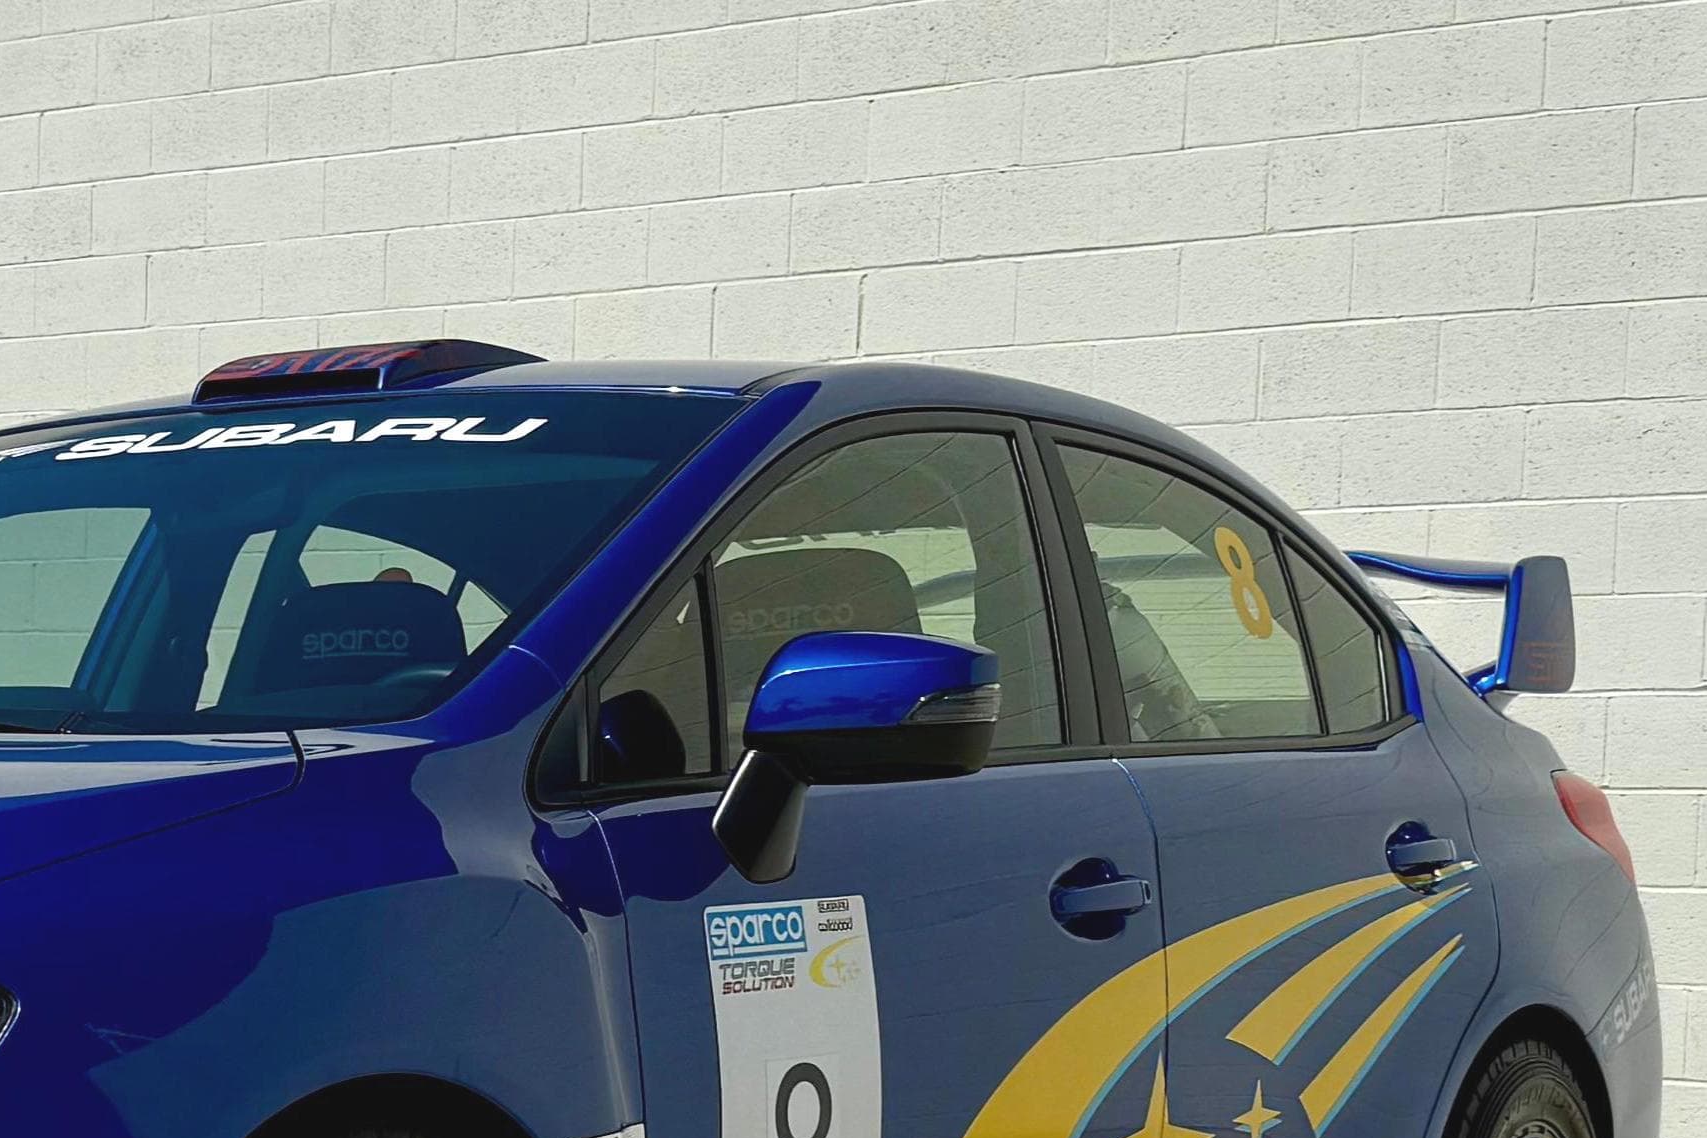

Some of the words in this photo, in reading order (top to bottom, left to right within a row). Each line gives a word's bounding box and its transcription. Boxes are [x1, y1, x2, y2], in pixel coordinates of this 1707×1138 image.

[56, 417, 548, 461] SUBARU
[1214, 526, 1273, 640] 8
[302, 629, 410, 659] sparco
[710, 912, 803, 956] sparco
[719, 957, 795, 981] TORQUE
[722, 975, 795, 995] SOLUTION
